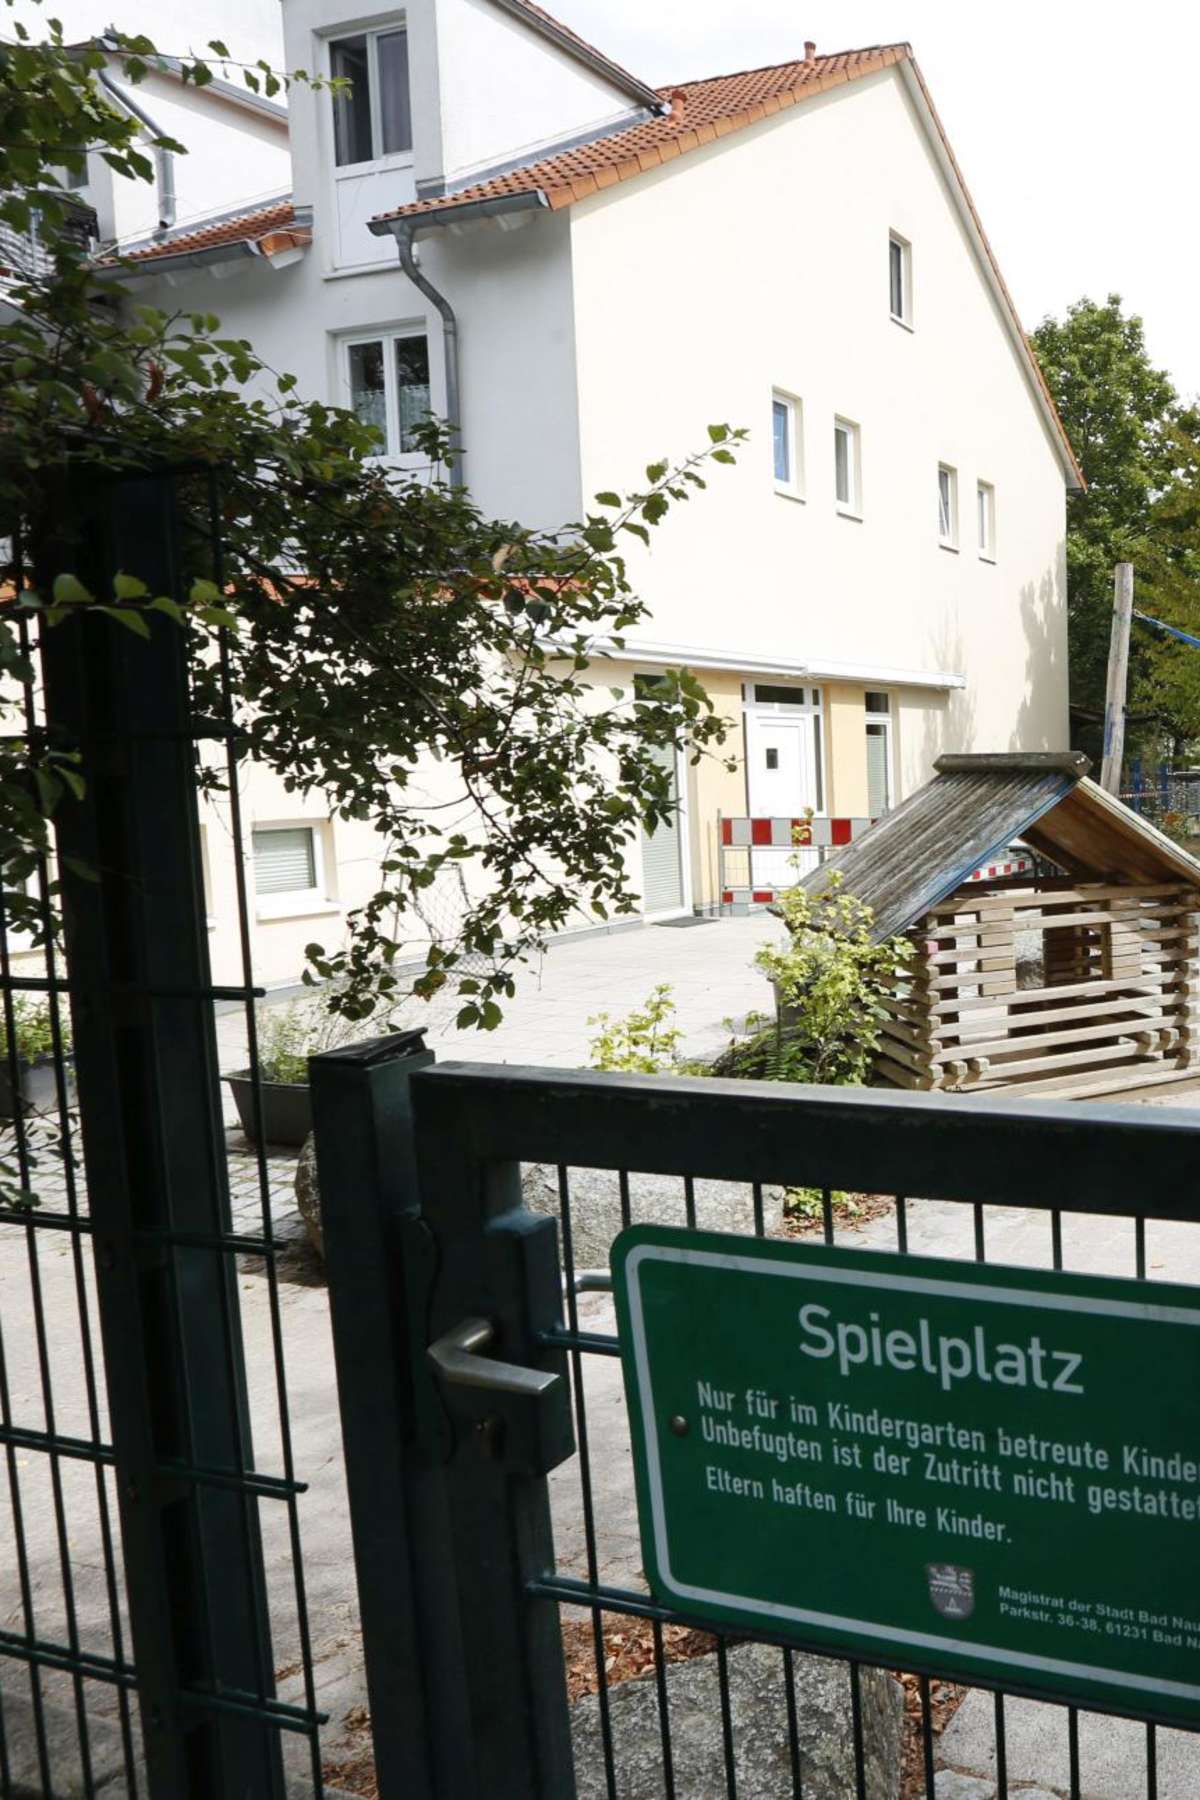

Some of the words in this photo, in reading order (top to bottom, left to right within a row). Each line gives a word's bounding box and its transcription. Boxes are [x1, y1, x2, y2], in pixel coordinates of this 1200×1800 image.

[798, 1303, 1084, 1394] Spielplatz
[697, 1380, 735, 1412] Nur
[745, 1389, 779, 1420] für
[789, 1395, 818, 1426] im
[827, 1401, 985, 1452] Kindergarten
[997, 1427, 1109, 1470] betreute
[701, 1415, 822, 1462] Unbefugten
[832, 1438, 863, 1469] ist
[873, 1446, 911, 1476] der
[924, 1453, 1002, 1491] Zutritt
[1013, 1469, 1076, 1503] nicht
[705, 1466, 764, 1499] Eltern
[772, 1478, 836, 1513] haften
[845, 1492, 876, 1519] für
[886, 1498, 927, 1528] Ihre
[936, 1507, 1013, 1543] Kinder.
[999, 1585, 1065, 1609] Magistrat
[1067, 1599, 1092, 1613] der
[1095, 1603, 1136, 1621] Stadt
[1138, 1610, 1168, 1627] Bad
[999, 1602, 1054, 1624] Parkstr.
[1105, 1624, 1148, 1640] 61231
[1152, 1631, 1182, 1648] Bad
